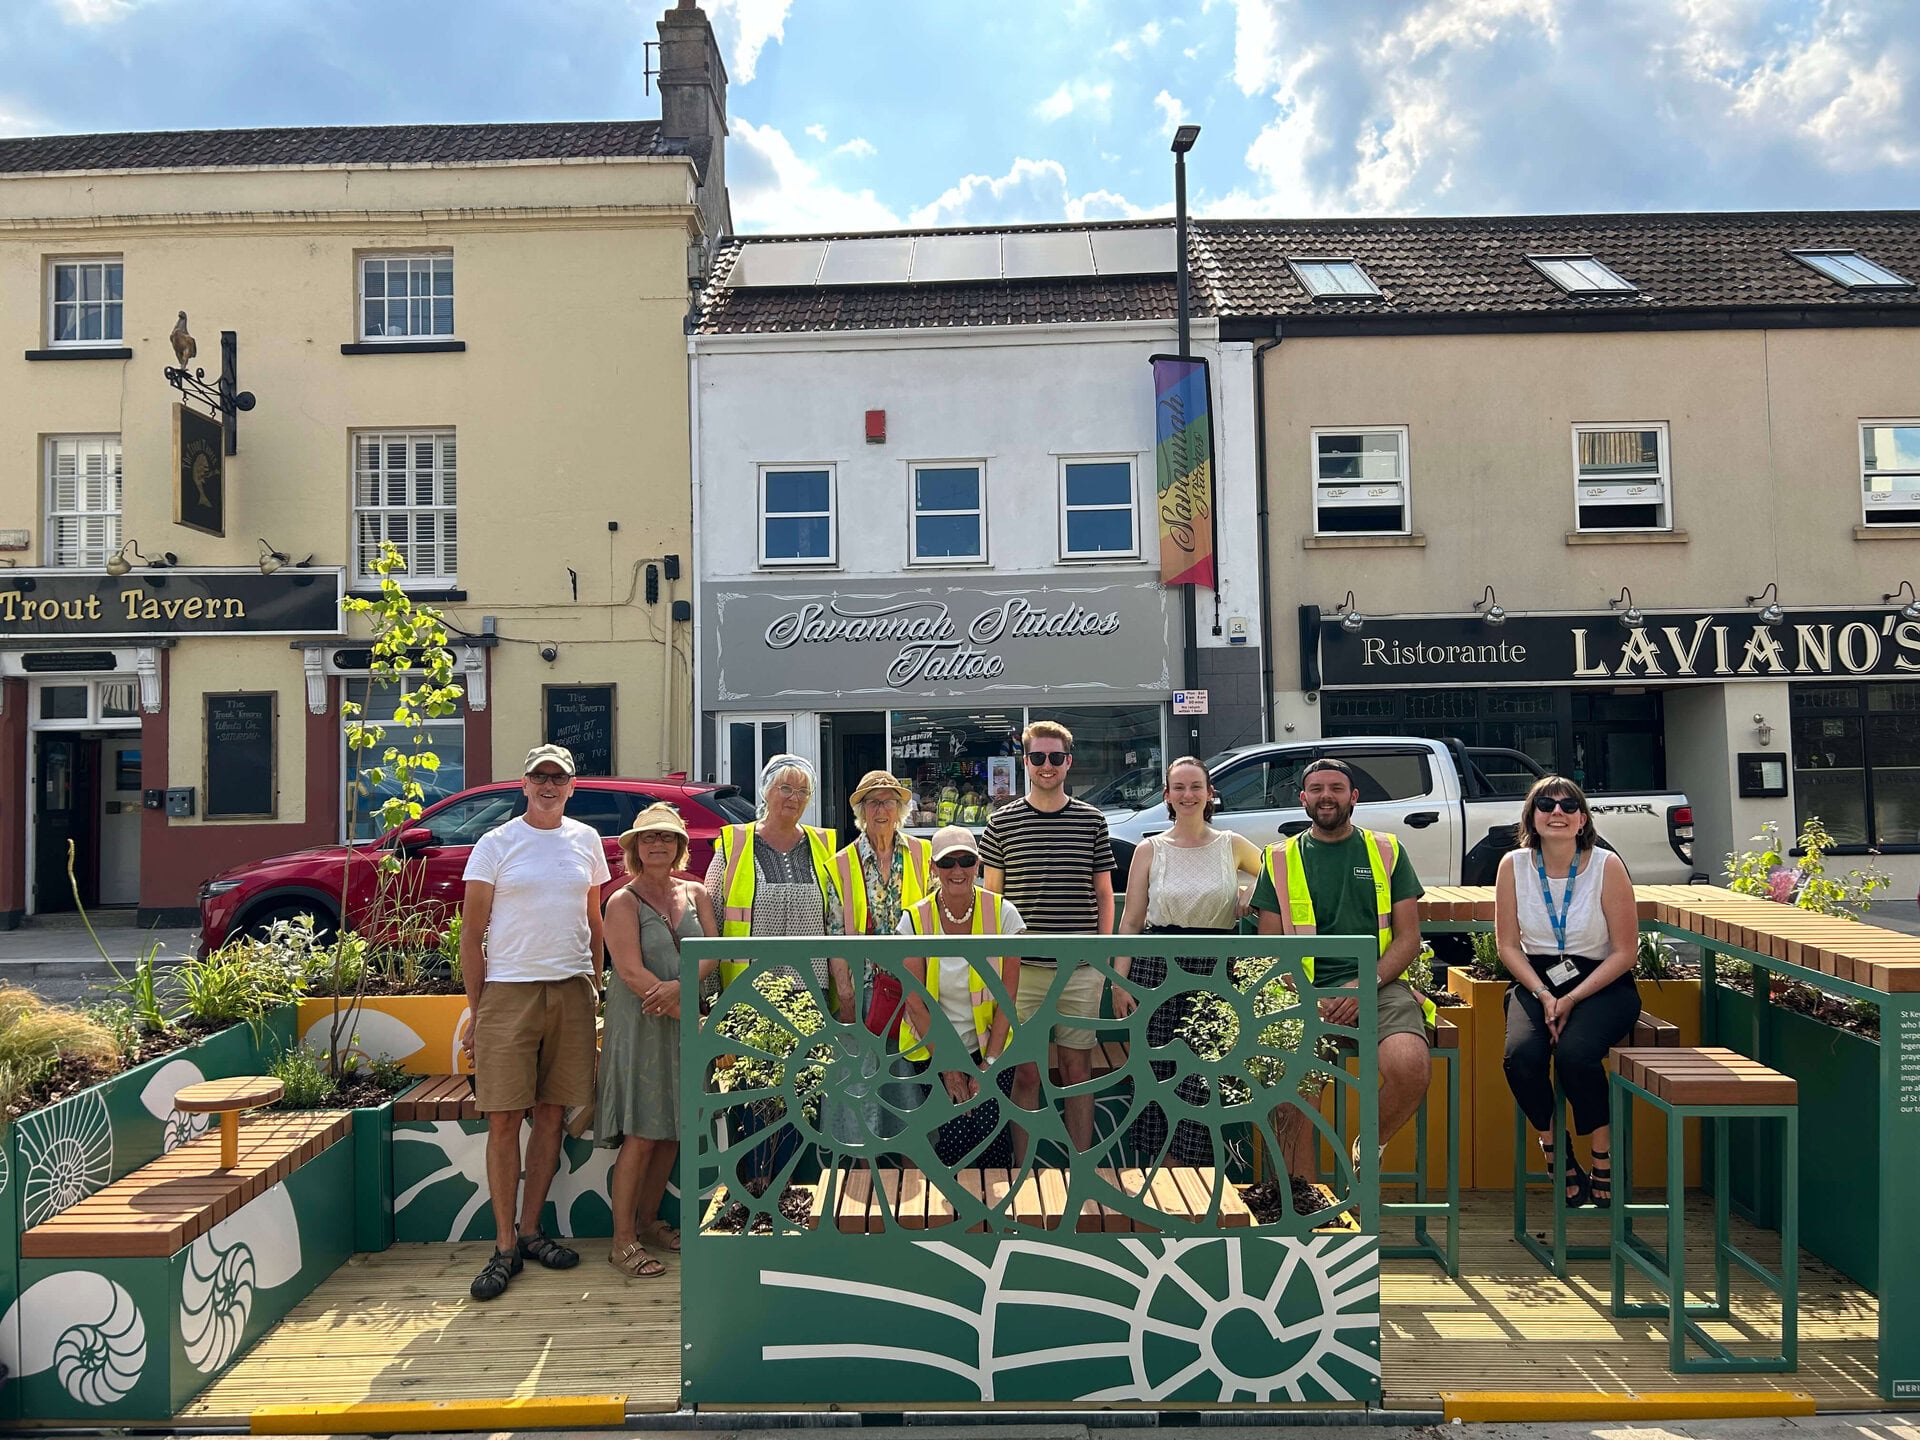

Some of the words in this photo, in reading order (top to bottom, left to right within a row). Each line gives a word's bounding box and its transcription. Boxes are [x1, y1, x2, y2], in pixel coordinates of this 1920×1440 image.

[1158, 393, 1195, 552] Savannah
[0, 590, 101, 621] Trout
[120, 589, 246, 620] Tavern
[764, 599, 956, 650] Savannah
[968, 597, 1120, 645] Studios
[1361, 637, 1527, 666] Ristorante
[1570, 615, 1920, 677] LAVIANO'S
[885, 638, 1005, 688] Tattoo
[568, 693, 587, 702] The
[1176, 694, 1184, 703] P
[1901, 1020, 1916, 1029] who
[1901, 1084, 1913, 1092] are
